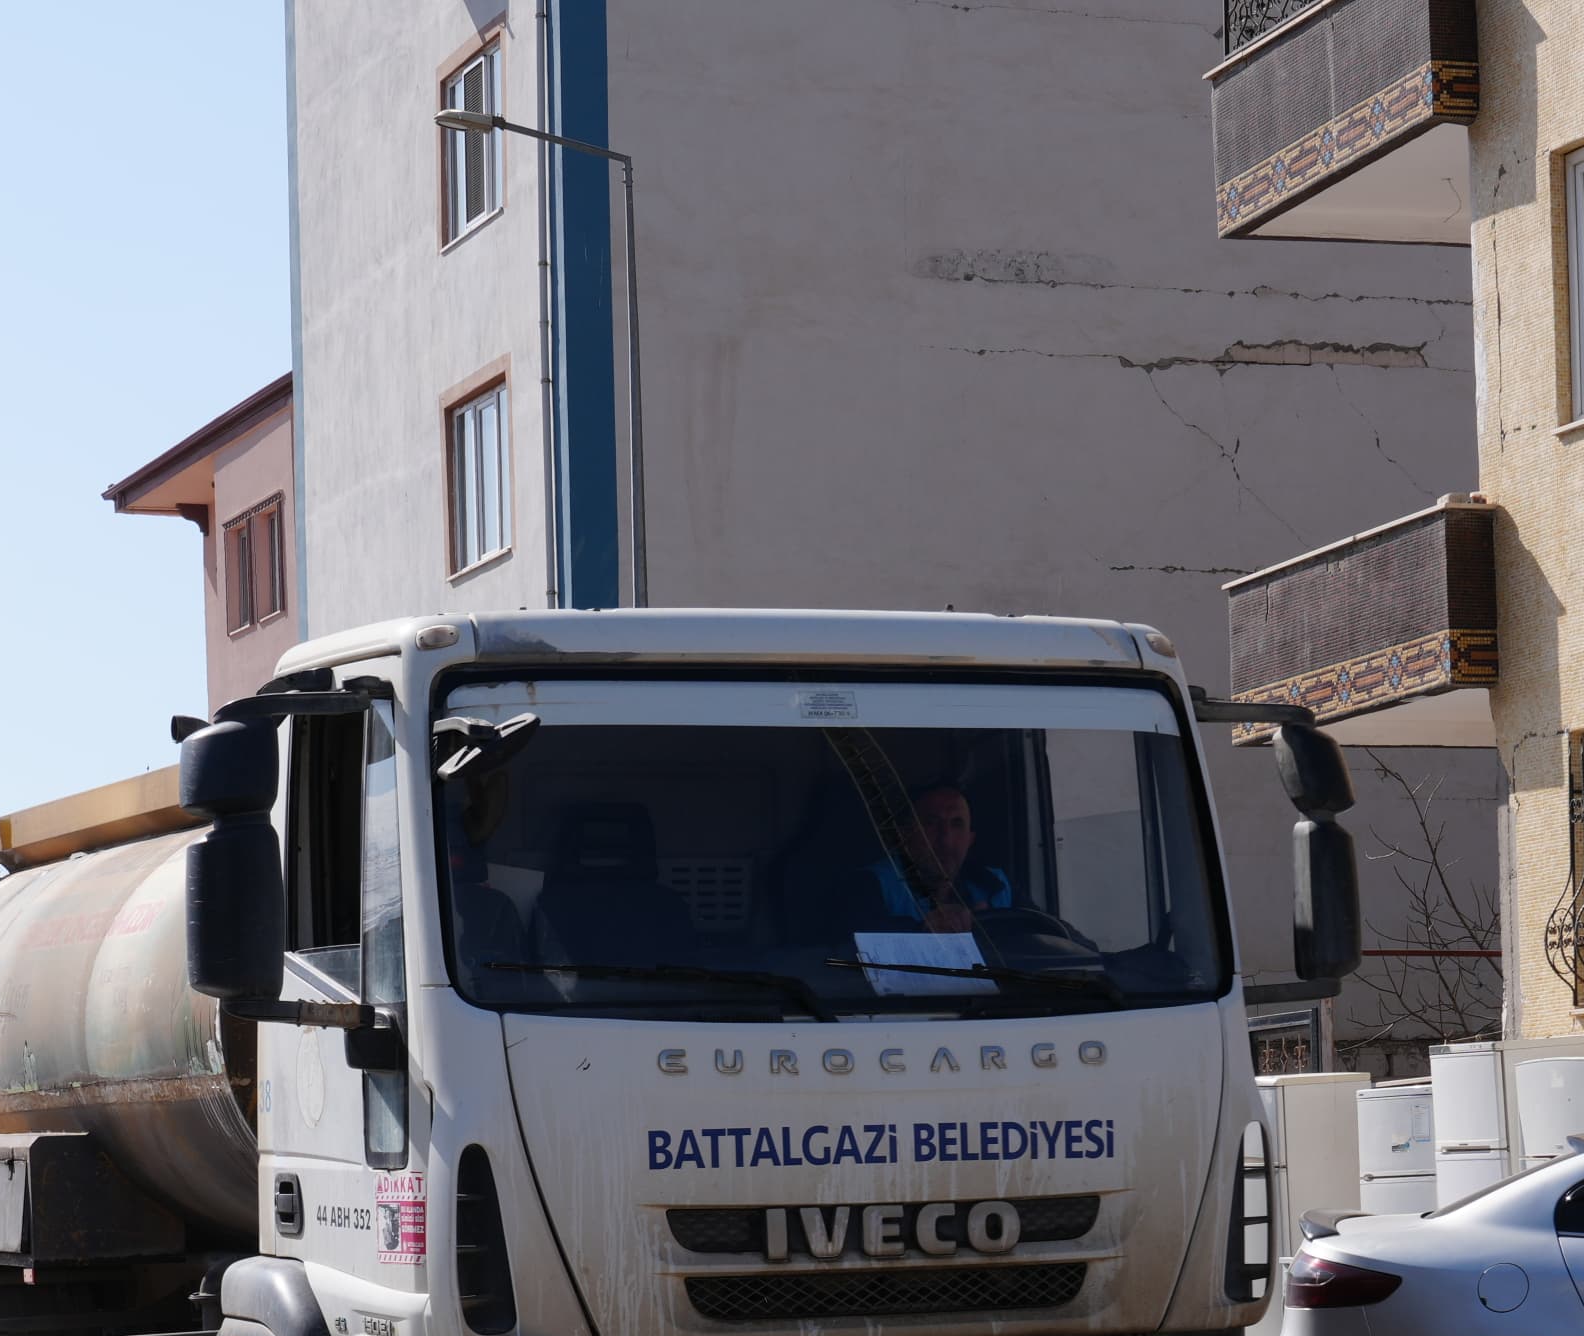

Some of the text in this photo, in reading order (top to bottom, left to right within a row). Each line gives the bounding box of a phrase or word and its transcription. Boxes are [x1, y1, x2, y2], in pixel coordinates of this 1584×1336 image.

[656, 1040, 1108, 1076] EUROCARGO
[647, 1119, 1114, 1170] BATTALGAZİ BELEDİYESİ
[316, 1205, 371, 1231] 44 ABH 352
[766, 1200, 1021, 1262] IVECO
